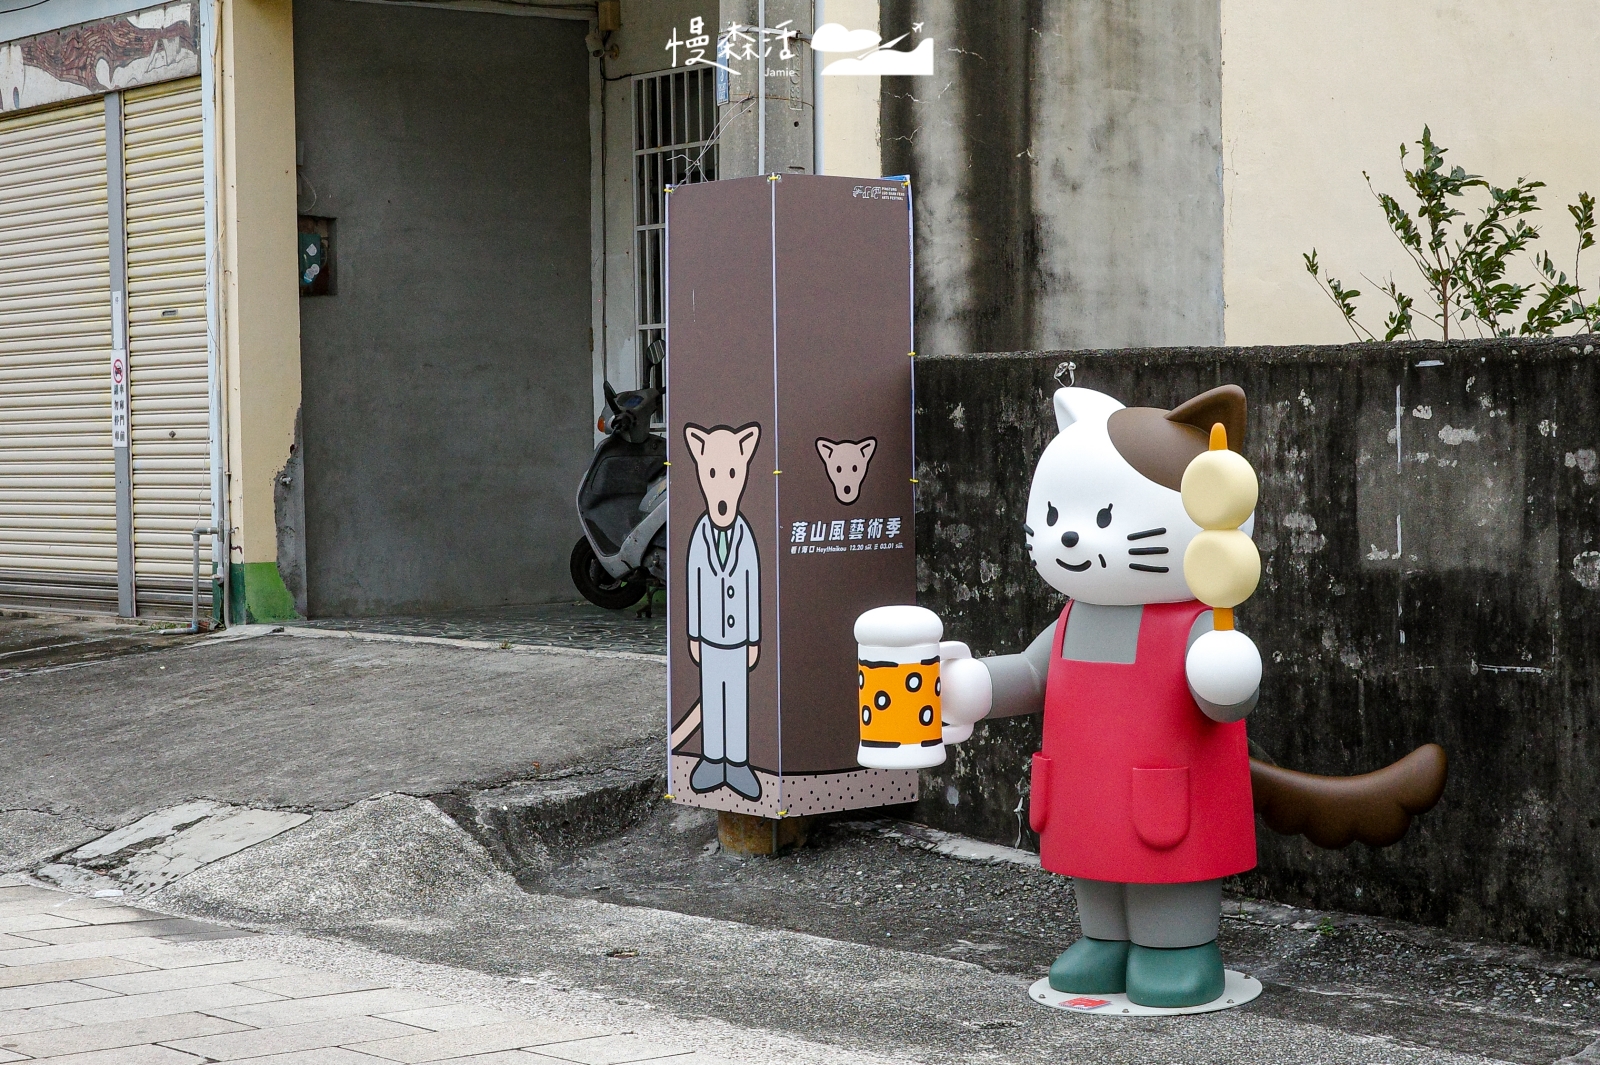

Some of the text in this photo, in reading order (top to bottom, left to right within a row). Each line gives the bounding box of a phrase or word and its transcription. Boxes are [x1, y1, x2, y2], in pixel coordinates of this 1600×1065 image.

[791, 517, 901, 543] 落山風藝術季
[849, 543, 864, 551] 12.20
[879, 542, 894, 550] 03.01
